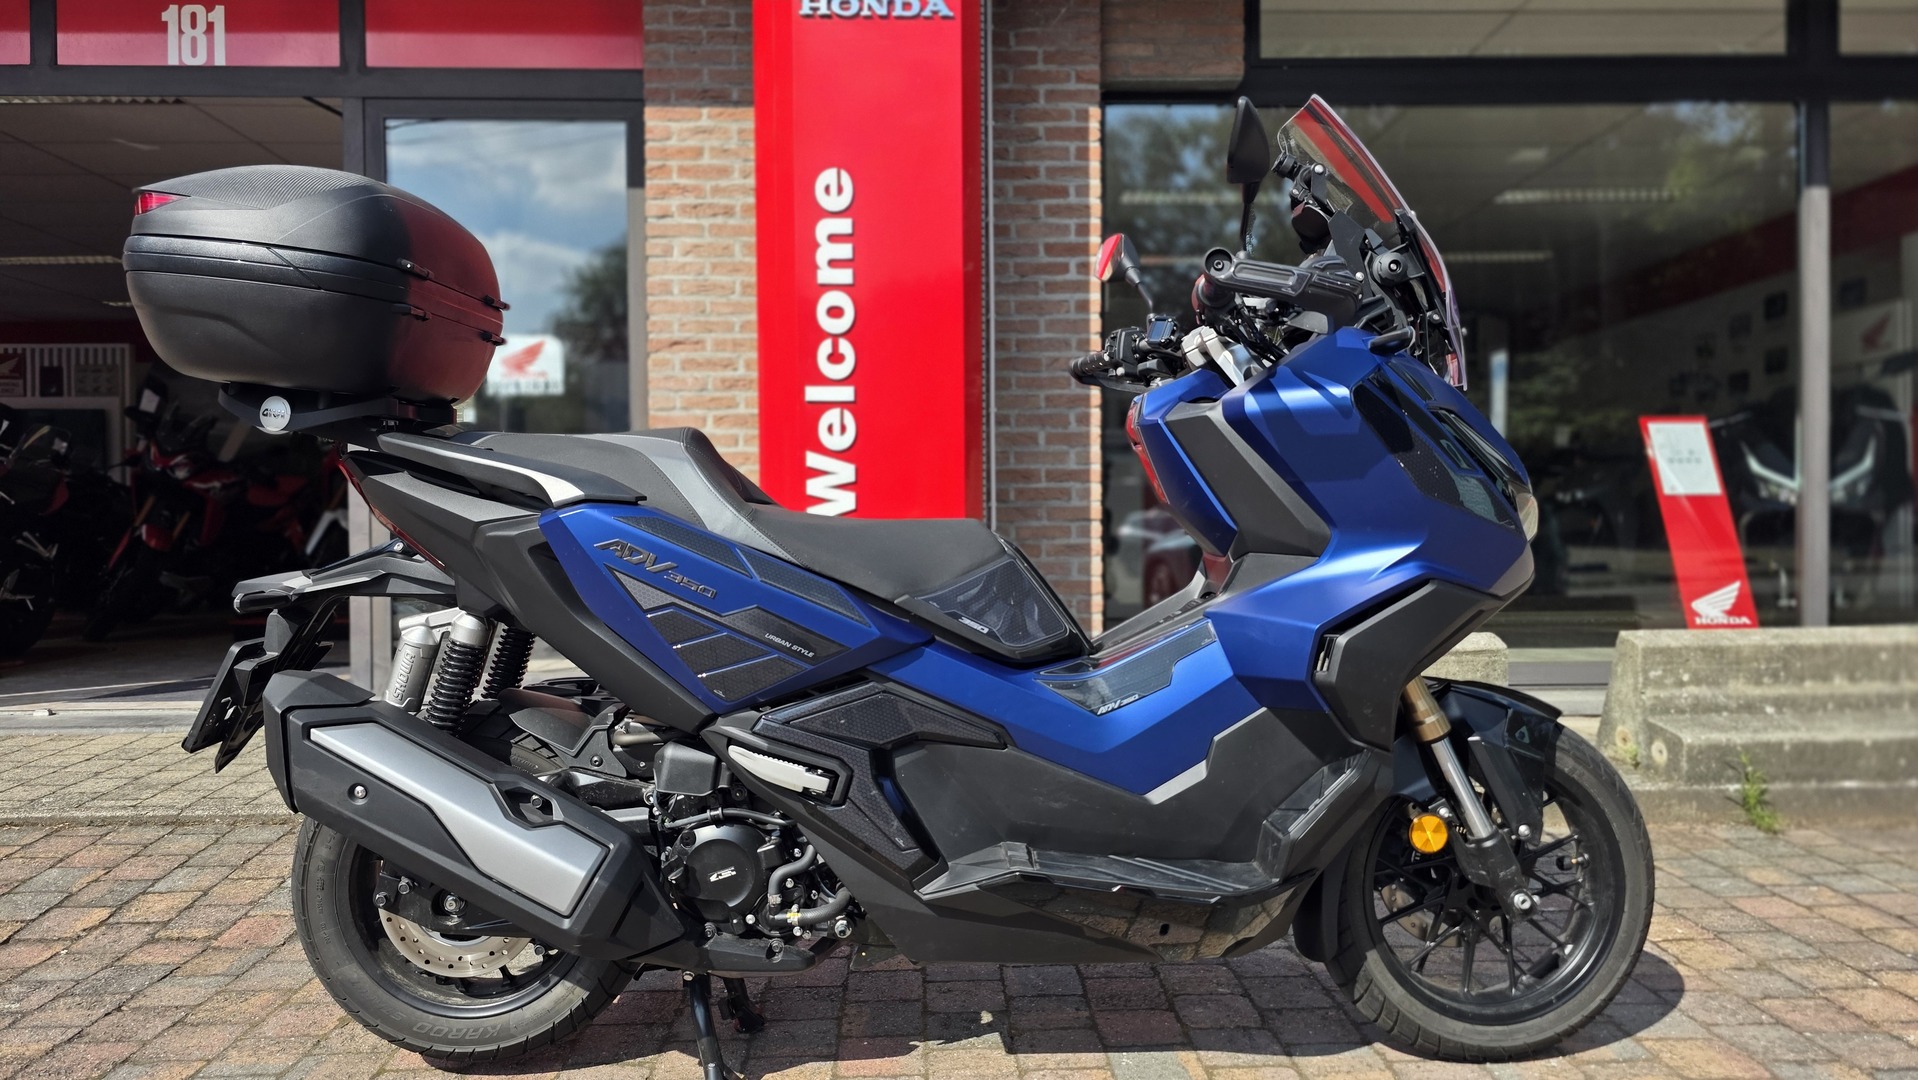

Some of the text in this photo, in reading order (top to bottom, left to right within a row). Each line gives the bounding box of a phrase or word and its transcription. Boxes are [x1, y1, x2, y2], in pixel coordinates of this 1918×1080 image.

[799, 0, 954, 17] HONDA
[161, 4, 226, 66] 181
[804, 167, 857, 517] Welcome
[593, 538, 718, 600] ADV 350
[1695, 616, 1752, 625] HONDA
[765, 632, 815, 658] URBAN STYLE
[392, 651, 416, 701] SHOWA
[412, 1022, 502, 1040] KAROO
